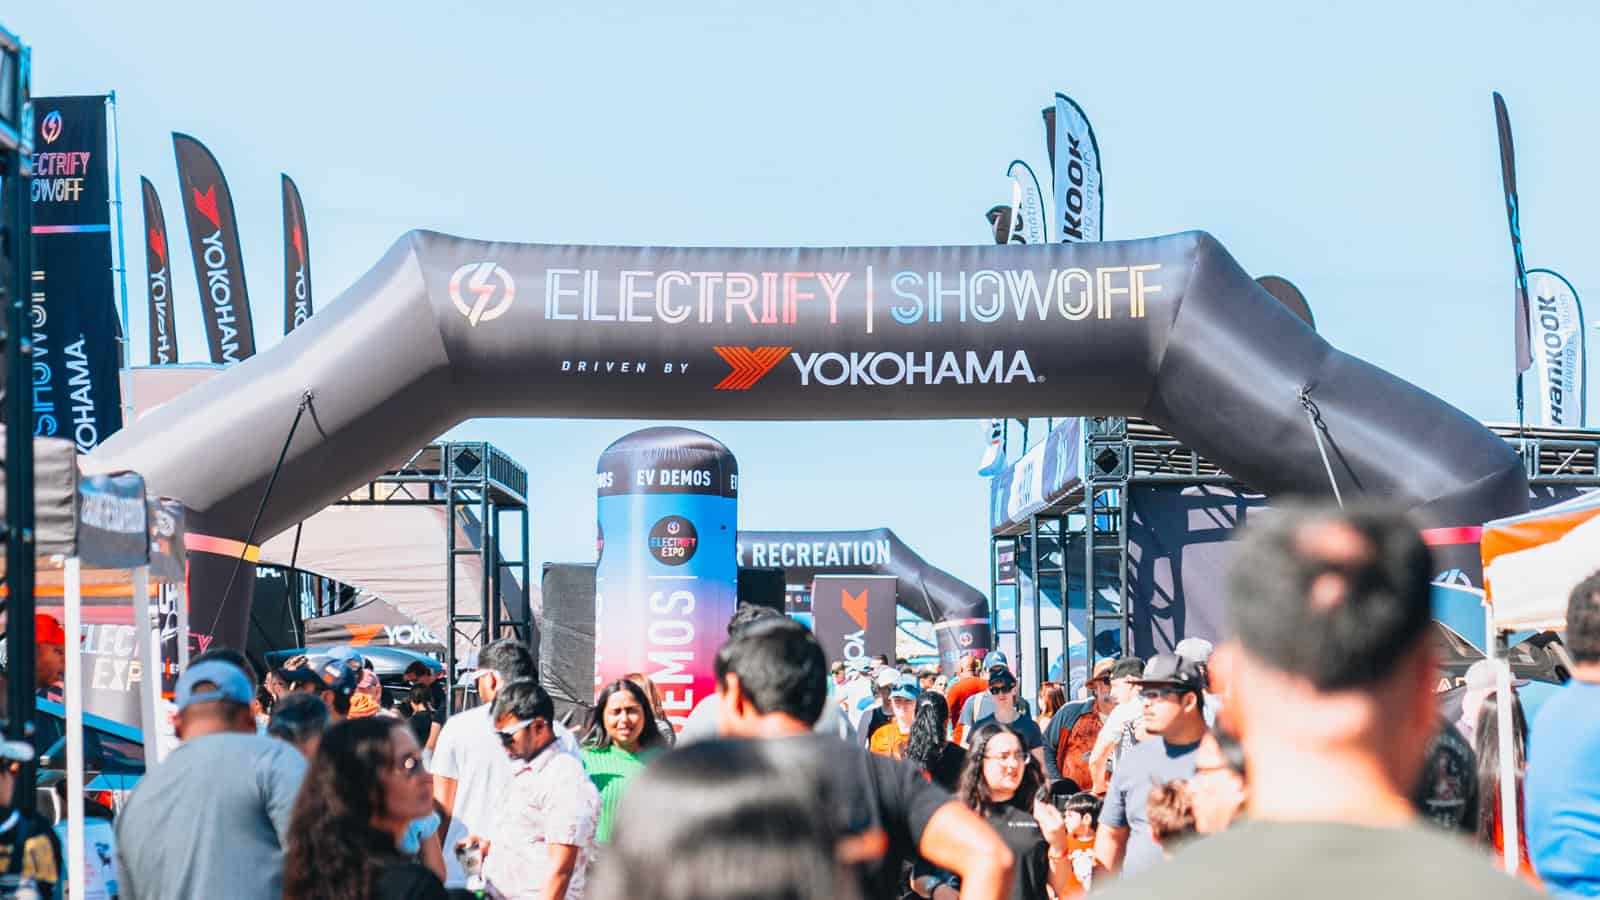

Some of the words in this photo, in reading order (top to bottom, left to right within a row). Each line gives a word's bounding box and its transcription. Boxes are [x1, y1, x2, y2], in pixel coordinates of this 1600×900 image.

[202, 230, 243, 366] YOKOHAM
[545, 268, 852, 324] ELECTRIFY
[890, 264, 1162, 324] SHOWOFF
[561, 361, 646, 374] DRIVEN
[664, 362, 690, 375] BY
[791, 350, 1037, 386] YOKOHAMA
[637, 470, 656, 487] EV
[660, 469, 712, 487] DEMOS
[752, 538, 892, 568] RECREATION
